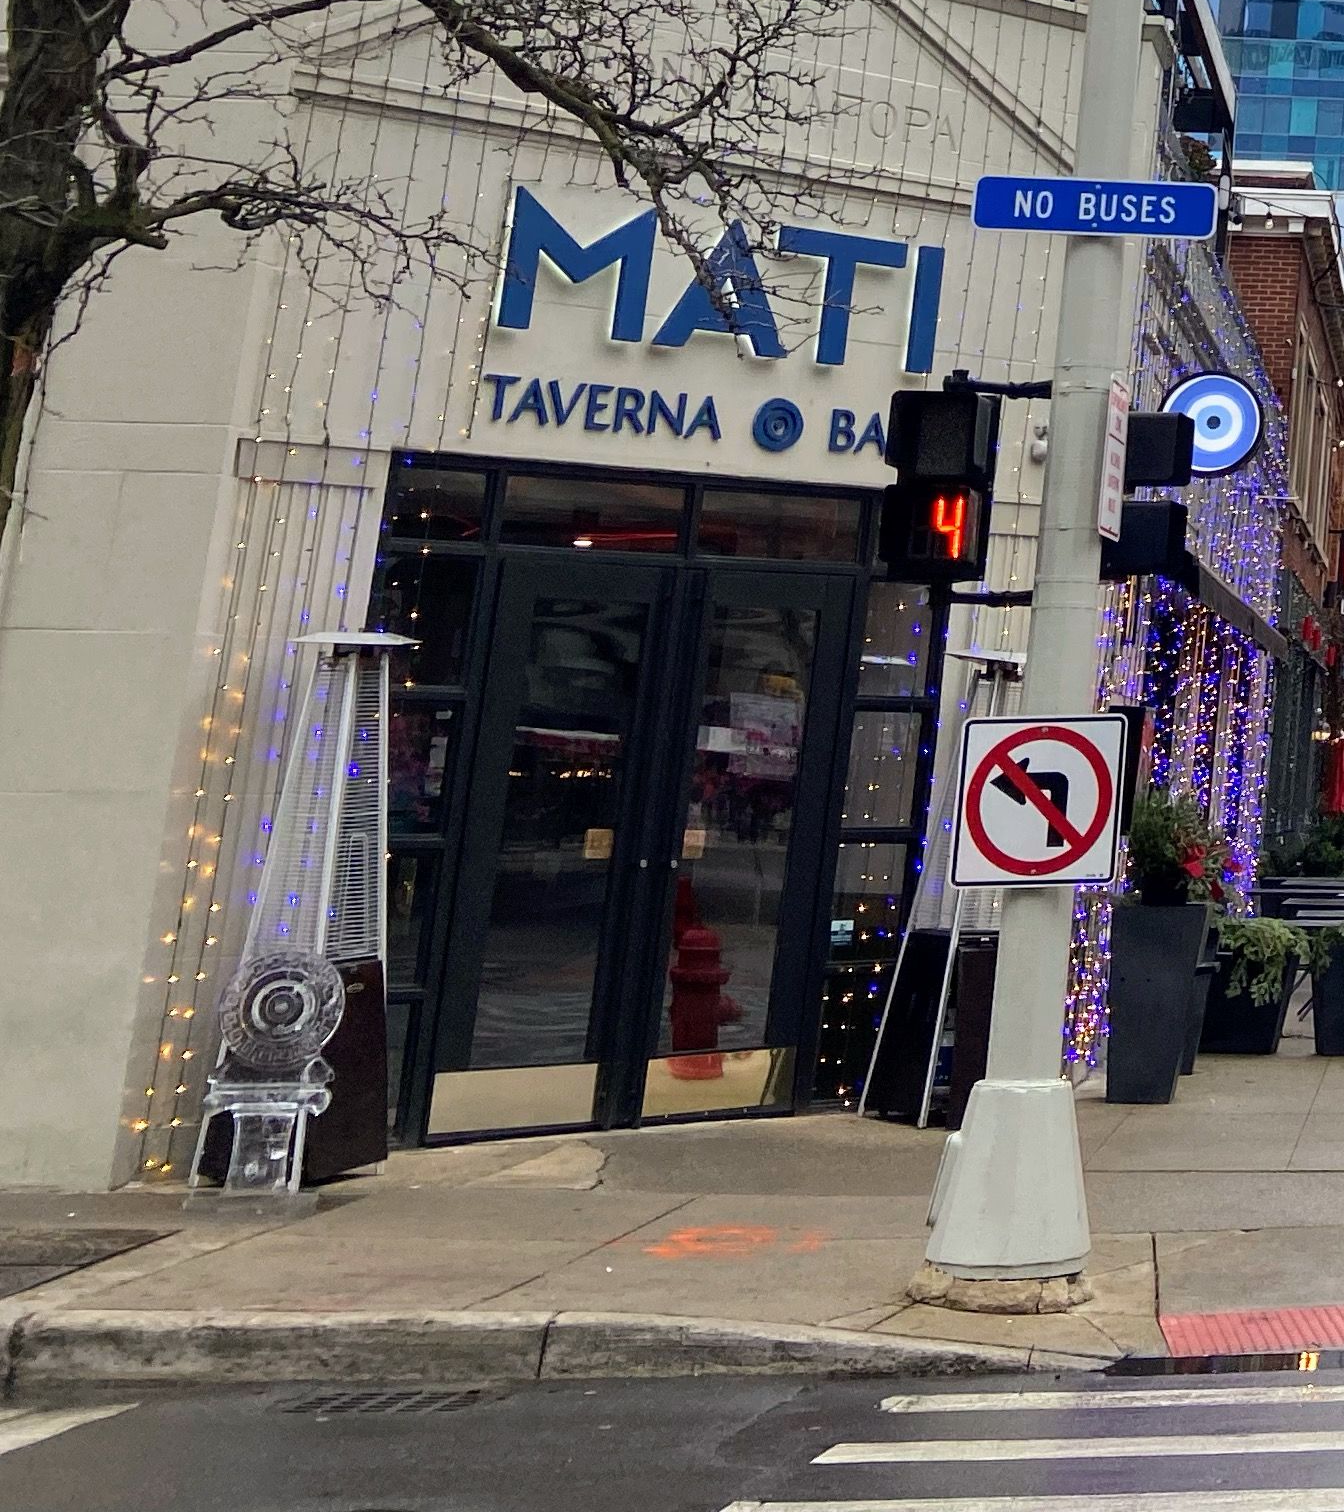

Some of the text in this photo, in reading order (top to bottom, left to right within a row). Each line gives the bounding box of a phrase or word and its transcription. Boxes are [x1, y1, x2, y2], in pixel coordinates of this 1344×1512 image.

[1013, 190, 1176, 224] NO BUSES
[496, 185, 945, 374] MATI
[483, 373, 887, 456] TAVERNA BA
[936, 496, 965, 559] 4
